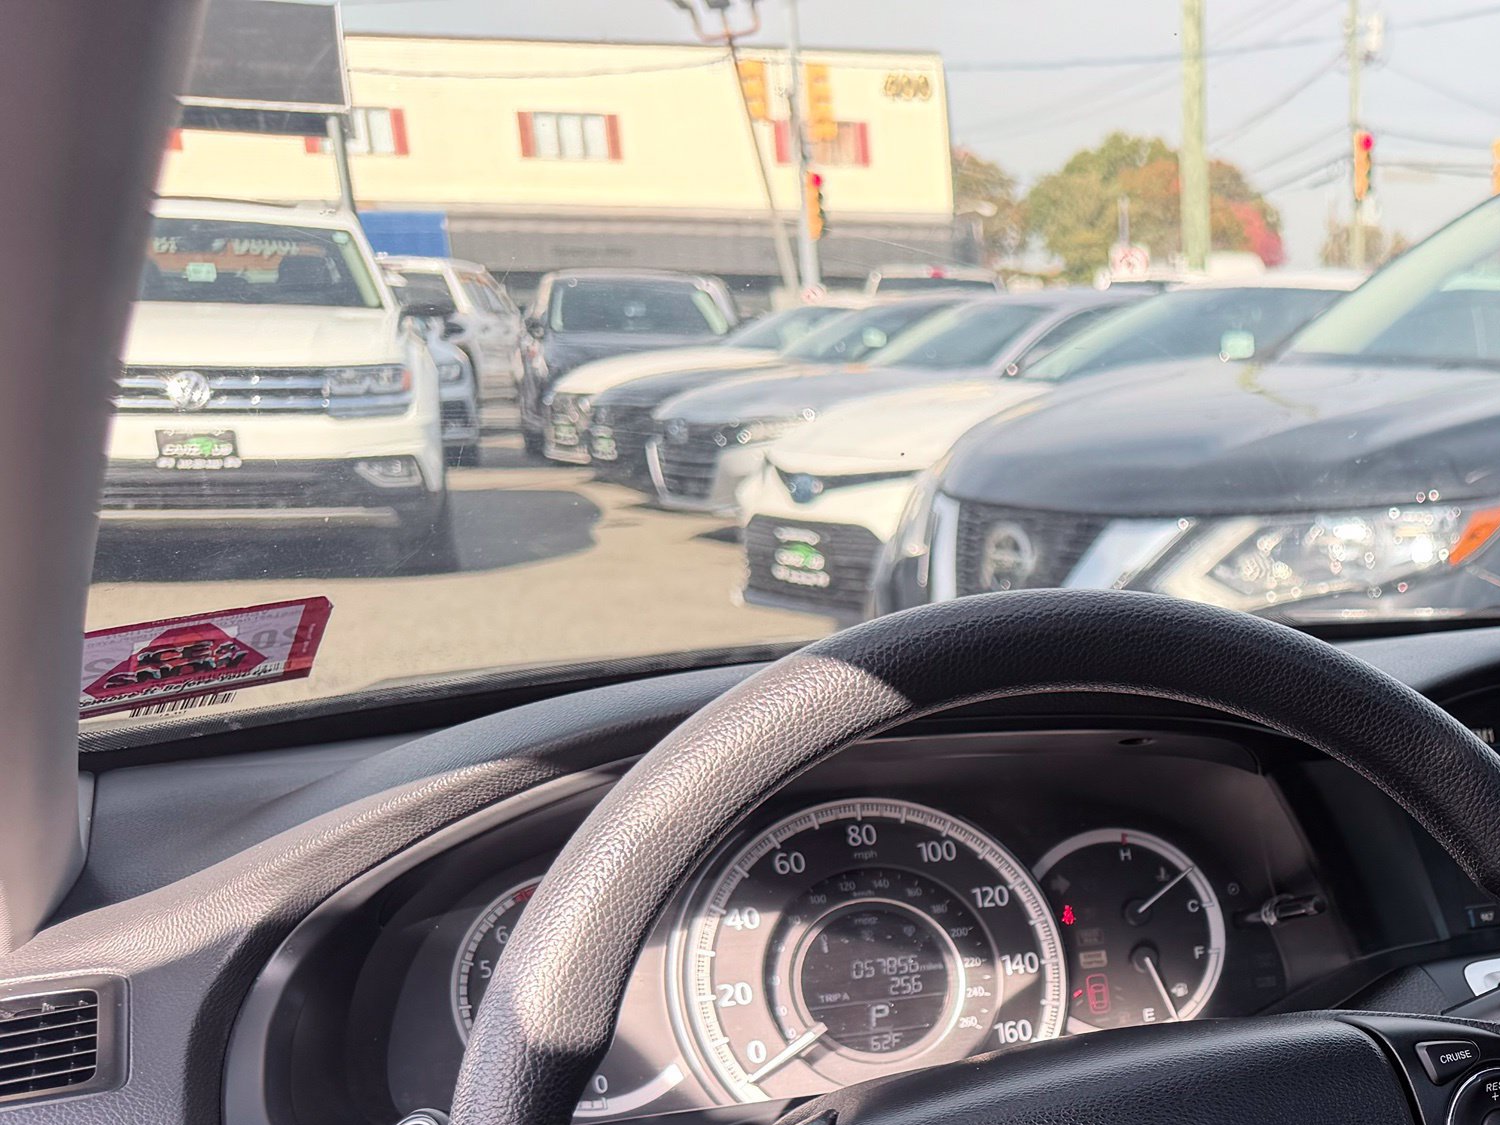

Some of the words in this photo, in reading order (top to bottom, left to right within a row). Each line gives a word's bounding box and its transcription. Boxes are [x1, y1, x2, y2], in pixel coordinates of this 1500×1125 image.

[848, 825, 877, 847] 80
[853, 850, 878, 861] mph
[918, 841, 957, 863] 100
[1119, 848, 1132, 861] H
[774, 853, 806, 875] 60
[840, 881, 856, 891] 120
[971, 886, 1011, 908] 120
[1186, 899, 1200, 912] C
[726, 907, 760, 930] 40
[495, 926, 510, 945] 6
[1194, 945, 1205, 960] F
[478, 961, 493, 979] 5
[1002, 952, 1041, 976] 140
[717, 982, 753, 1008] 20
[870, 1004, 891, 1028] P
[1143, 1007, 1155, 1023] E
[994, 1019, 1033, 1045] 160
[746, 1040, 767, 1064] 0
[1439, 1049, 1472, 1065] CRUISE
[592, 1074, 609, 1094] 0
